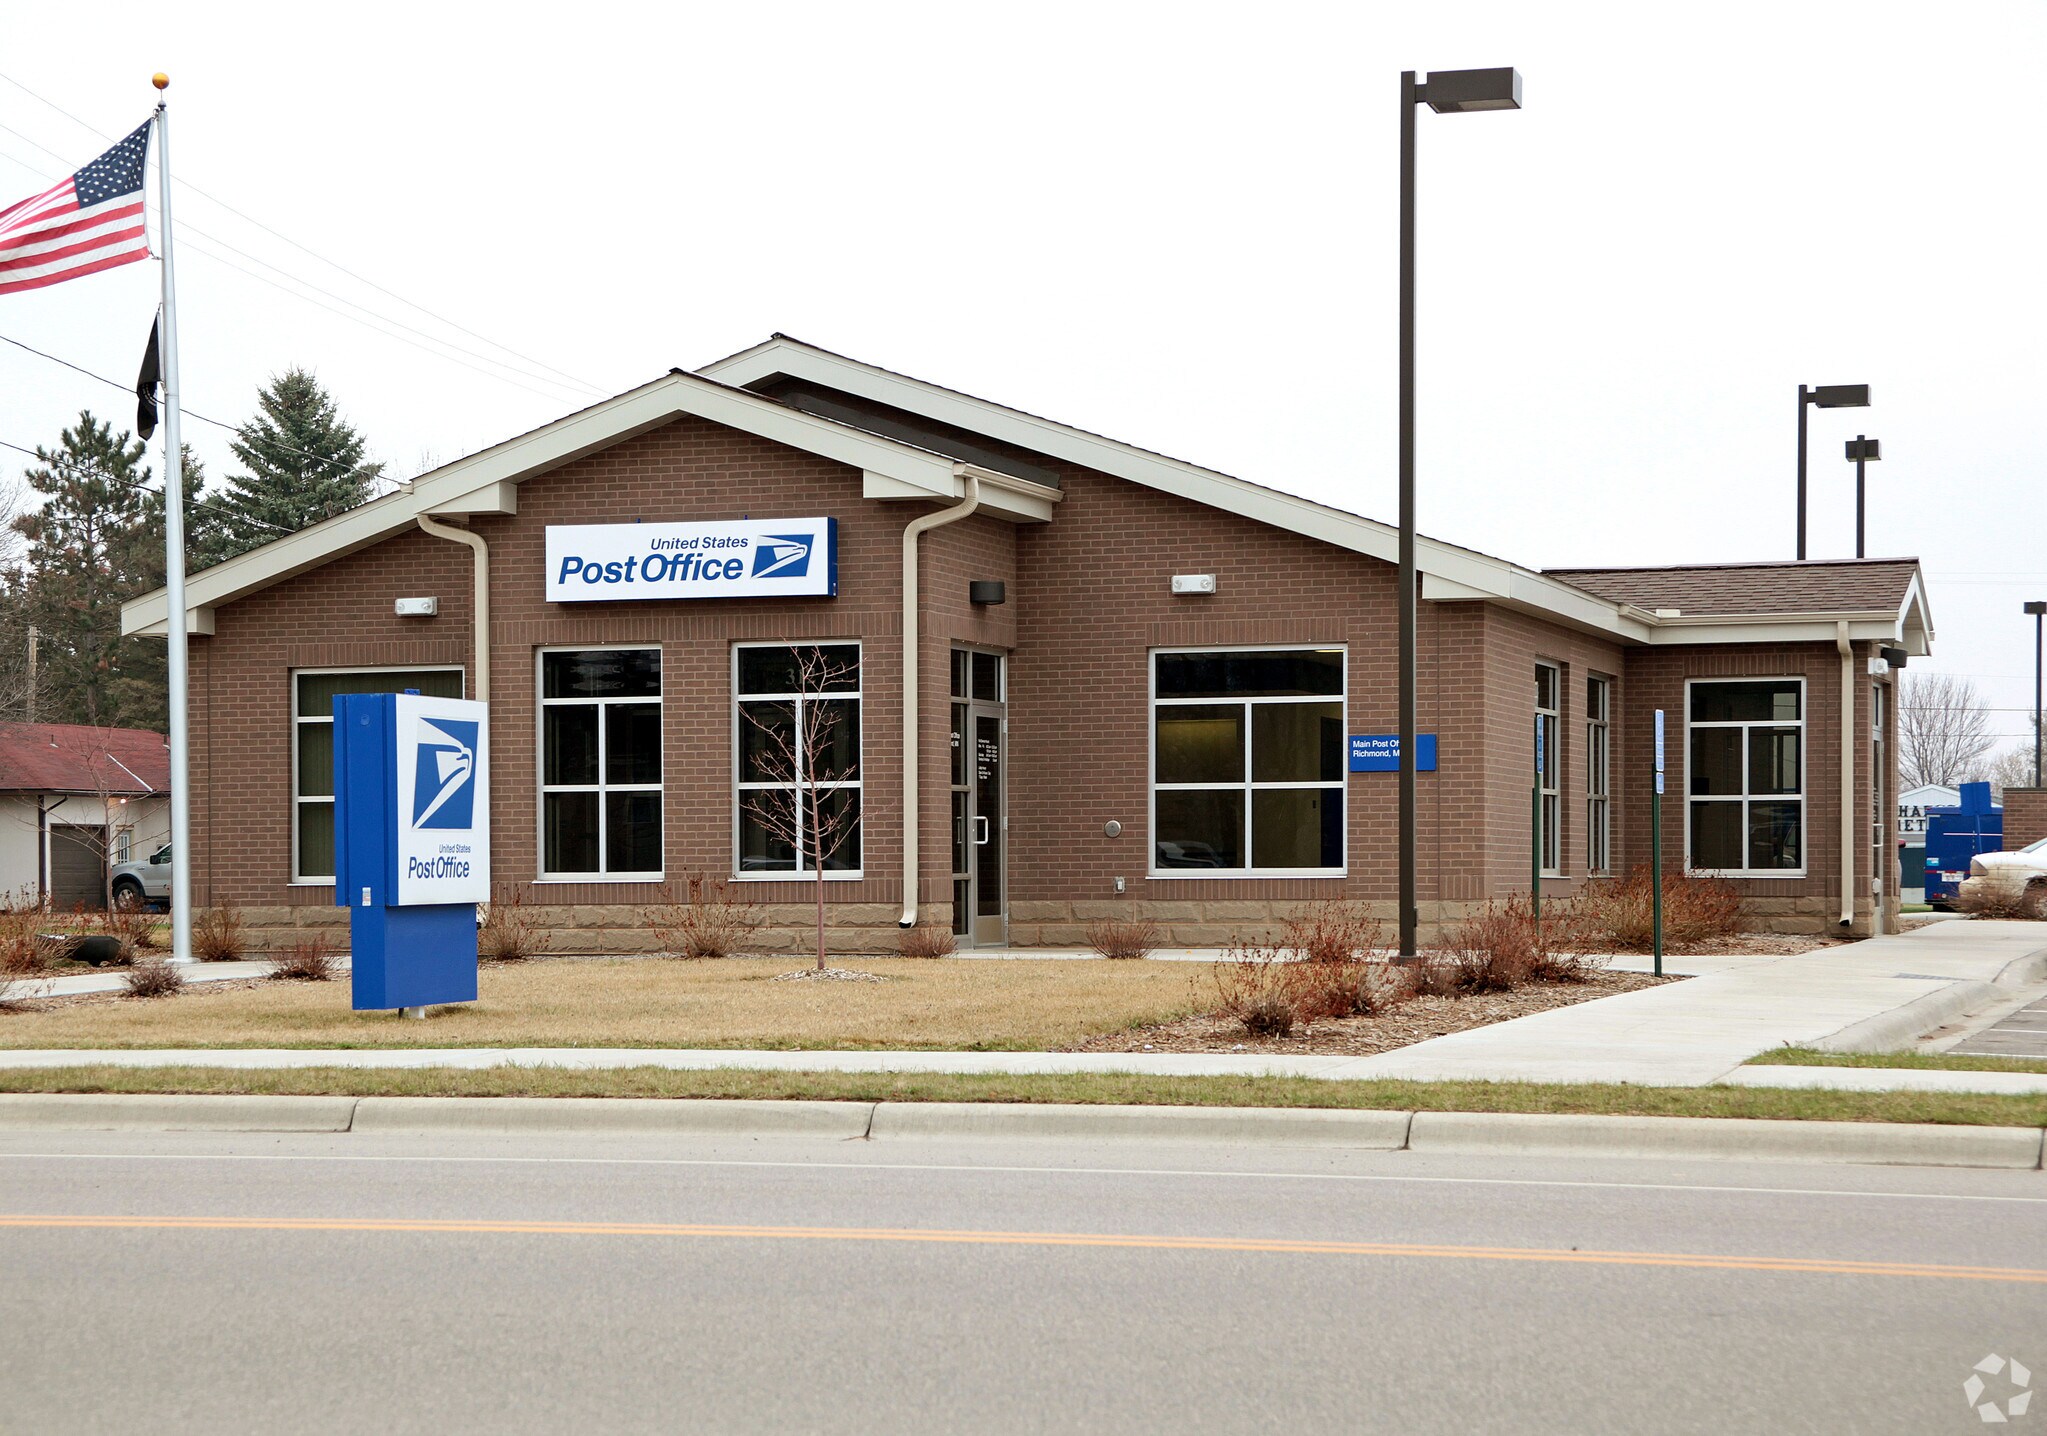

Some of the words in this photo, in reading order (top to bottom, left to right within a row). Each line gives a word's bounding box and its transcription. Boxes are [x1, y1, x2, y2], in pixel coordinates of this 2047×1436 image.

[650, 537, 698, 550] United
[701, 536, 749, 549] States
[558, 555, 637, 585] Post
[640, 553, 744, 583] Office
[1352, 740, 1371, 748] Main
[1372, 740, 1389, 748] Post
[1352, 749, 1392, 758] Richmond,
[439, 844, 455, 854] United
[456, 843, 471, 854] States
[408, 856, 436, 879] Post
[436, 855, 470, 879] Office
